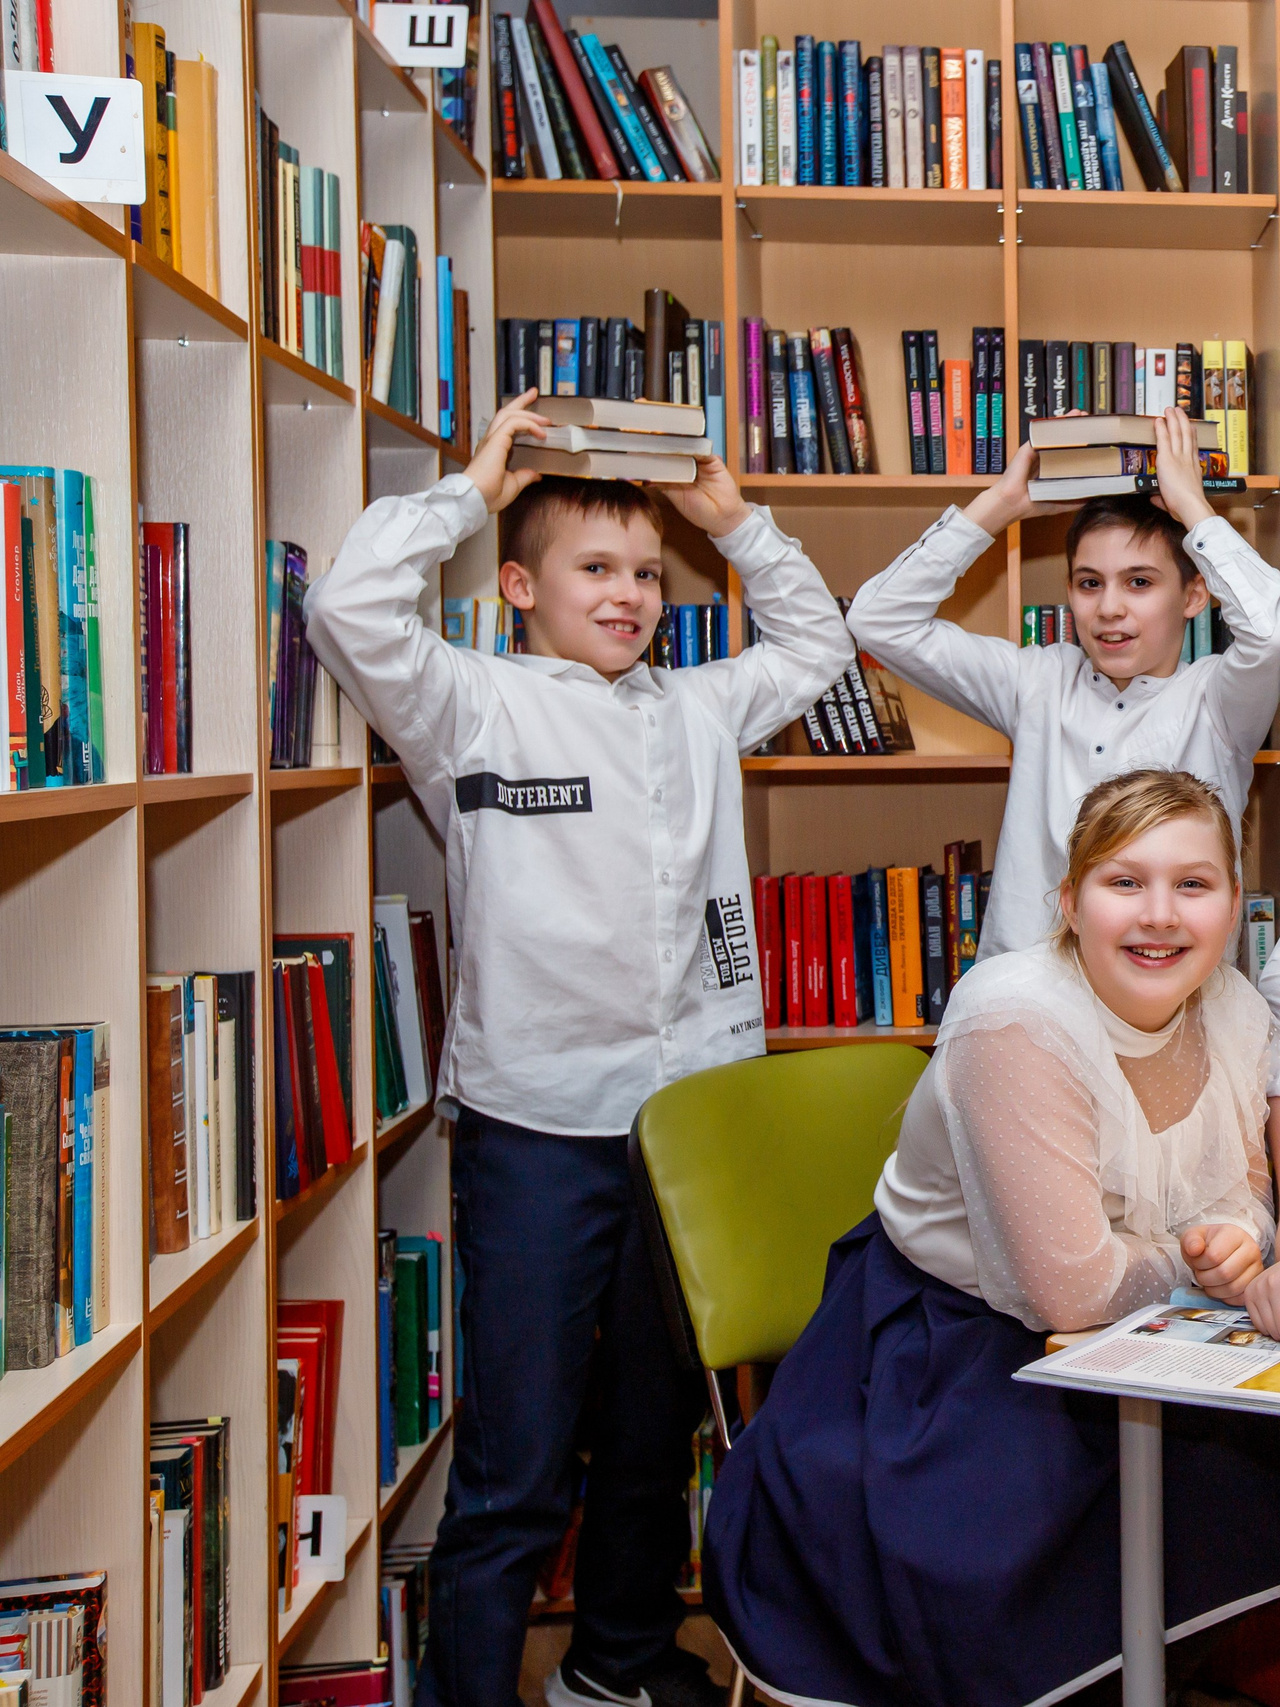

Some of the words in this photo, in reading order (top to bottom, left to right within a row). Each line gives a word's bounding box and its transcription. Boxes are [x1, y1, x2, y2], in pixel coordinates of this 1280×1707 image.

[409, 16, 454, 47] Ш
[45, 95, 111, 164] У
[1224, 171, 1232, 186] 2
[976, 393, 988, 438] ДАШКОВА
[992, 393, 1004, 437] ДАШКОВА
[13, 545, 21, 602] Стоунер
[805, 706, 822, 740] ПИТЕ
[826, 703, 845, 741] ПИТЕР
[843, 704, 862, 742] ПИТЕР
[859, 701, 878, 739] ПИТЕР
[496, 782, 585, 809] DIFFERENT
[925, 885, 942, 918] ДОЙЛЬ
[712, 937, 727, 962] NEW
[719, 894, 753, 985] FUTURE
[874, 931, 888, 977] ДИВЕР
[928, 926, 941, 957] КОНАН
[720, 962, 732, 983] FOR
